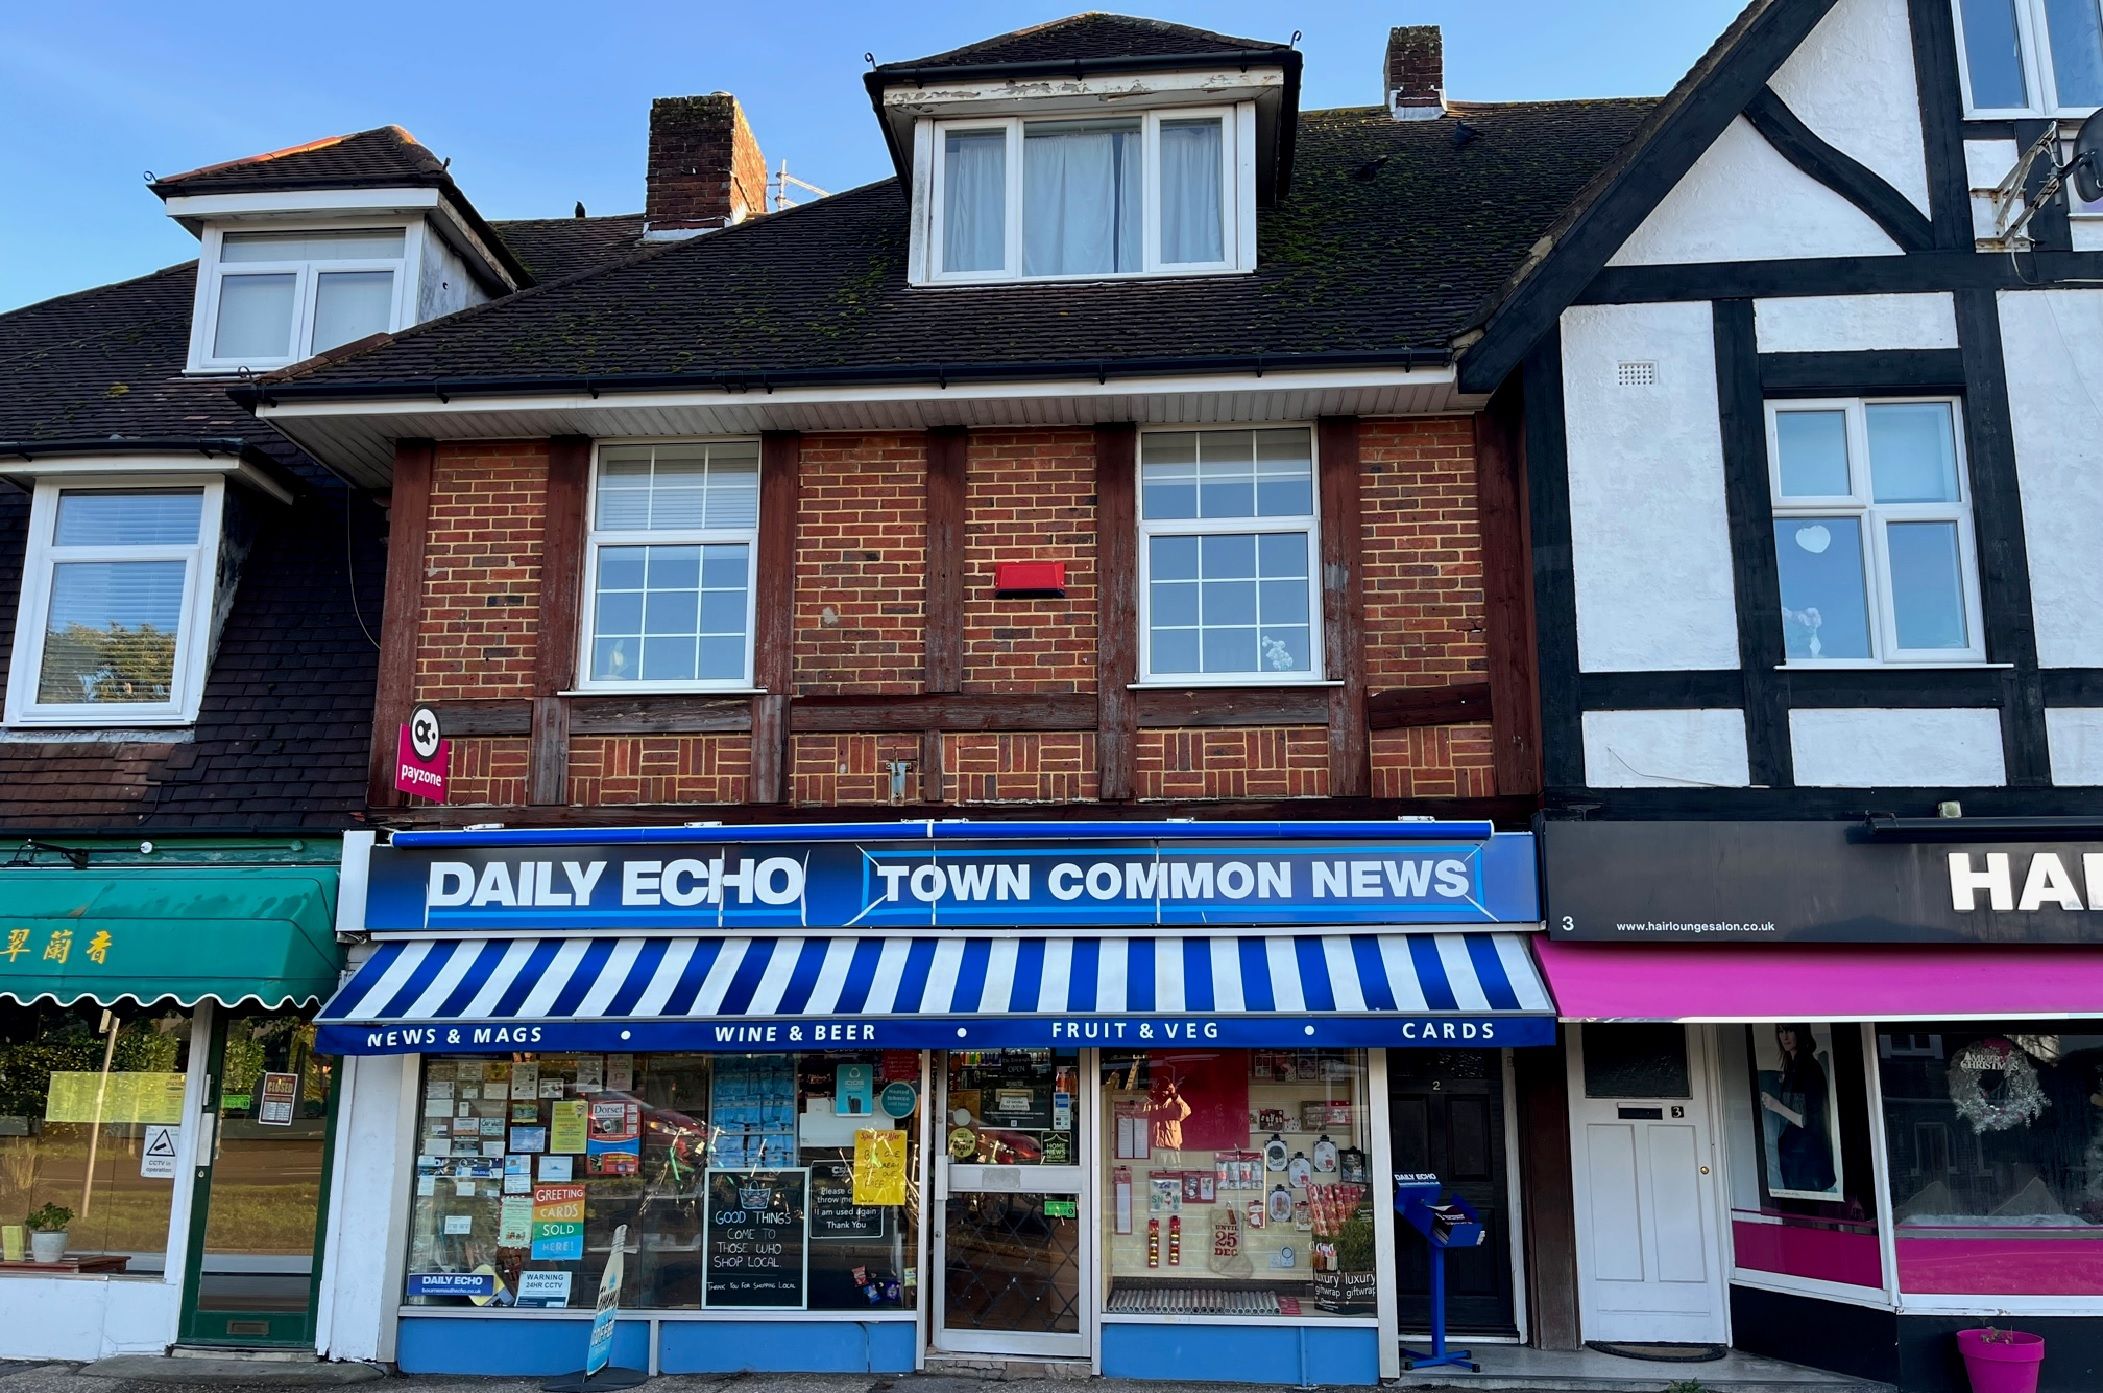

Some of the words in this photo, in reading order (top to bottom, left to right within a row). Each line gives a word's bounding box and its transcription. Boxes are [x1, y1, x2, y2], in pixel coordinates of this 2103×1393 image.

[401, 764, 442, 786] payzone
[428, 861, 608, 907] DAILY
[621, 857, 803, 906] ECHO
[877, 863, 1031, 902] TOWN
[1047, 860, 1293, 900] COMMON
[1312, 858, 1471, 898] NEWS
[1562, 916, 1575, 931] 3
[1616, 921, 1776, 933] www.hairloungesalon.co.uk
[367, 1027, 436, 1047] NEWS
[446, 1027, 461, 1044] &
[473, 1026, 543, 1044] MAGS
[715, 1026, 777, 1042] WINE
[789, 1026, 803, 1041] &
[815, 1025, 876, 1041] BEER
[1052, 1022, 1127, 1039] FRUIT
[1139, 1023, 1155, 1039] &
[1164, 1022, 1219, 1039] VEG
[1402, 1022, 1495, 1040] CARDS
[1960, 1059, 2019, 1071] CHRISTMS
[267, 1081, 293, 1093] CLOSED
[1432, 1081, 1441, 1091] 2
[594, 1105, 624, 1114] Dorset
[1671, 1106, 1683, 1118] 3
[536, 1189, 584, 1202] GREETING
[821, 1187, 846, 1196] Please
[1152, 1194, 1181, 1203] SNW
[540, 1204, 579, 1217] CARDS
[856, 1208, 877, 1217] again
[715, 1210, 747, 1225] GOOD
[753, 1210, 792, 1225] THINGS
[542, 1224, 575, 1236] SOLD
[826, 1221, 850, 1229] Thank
[851, 1221, 867, 1229] You
[727, 1228, 755, 1240] COME
[761, 1228, 776, 1240] TO
[1215, 1231, 1238, 1247] 25
[542, 1241, 574, 1252] HERE!
[716, 1241, 749, 1254] THOSE
[755, 1243, 782, 1255] WHO
[1214, 1248, 1239, 1257] DEC
[714, 1256, 744, 1268] SHOP
[421, 1276, 453, 1285] DAILY
[454, 1276, 483, 1285] ECHO
[1345, 1272, 1376, 1285] luxury
